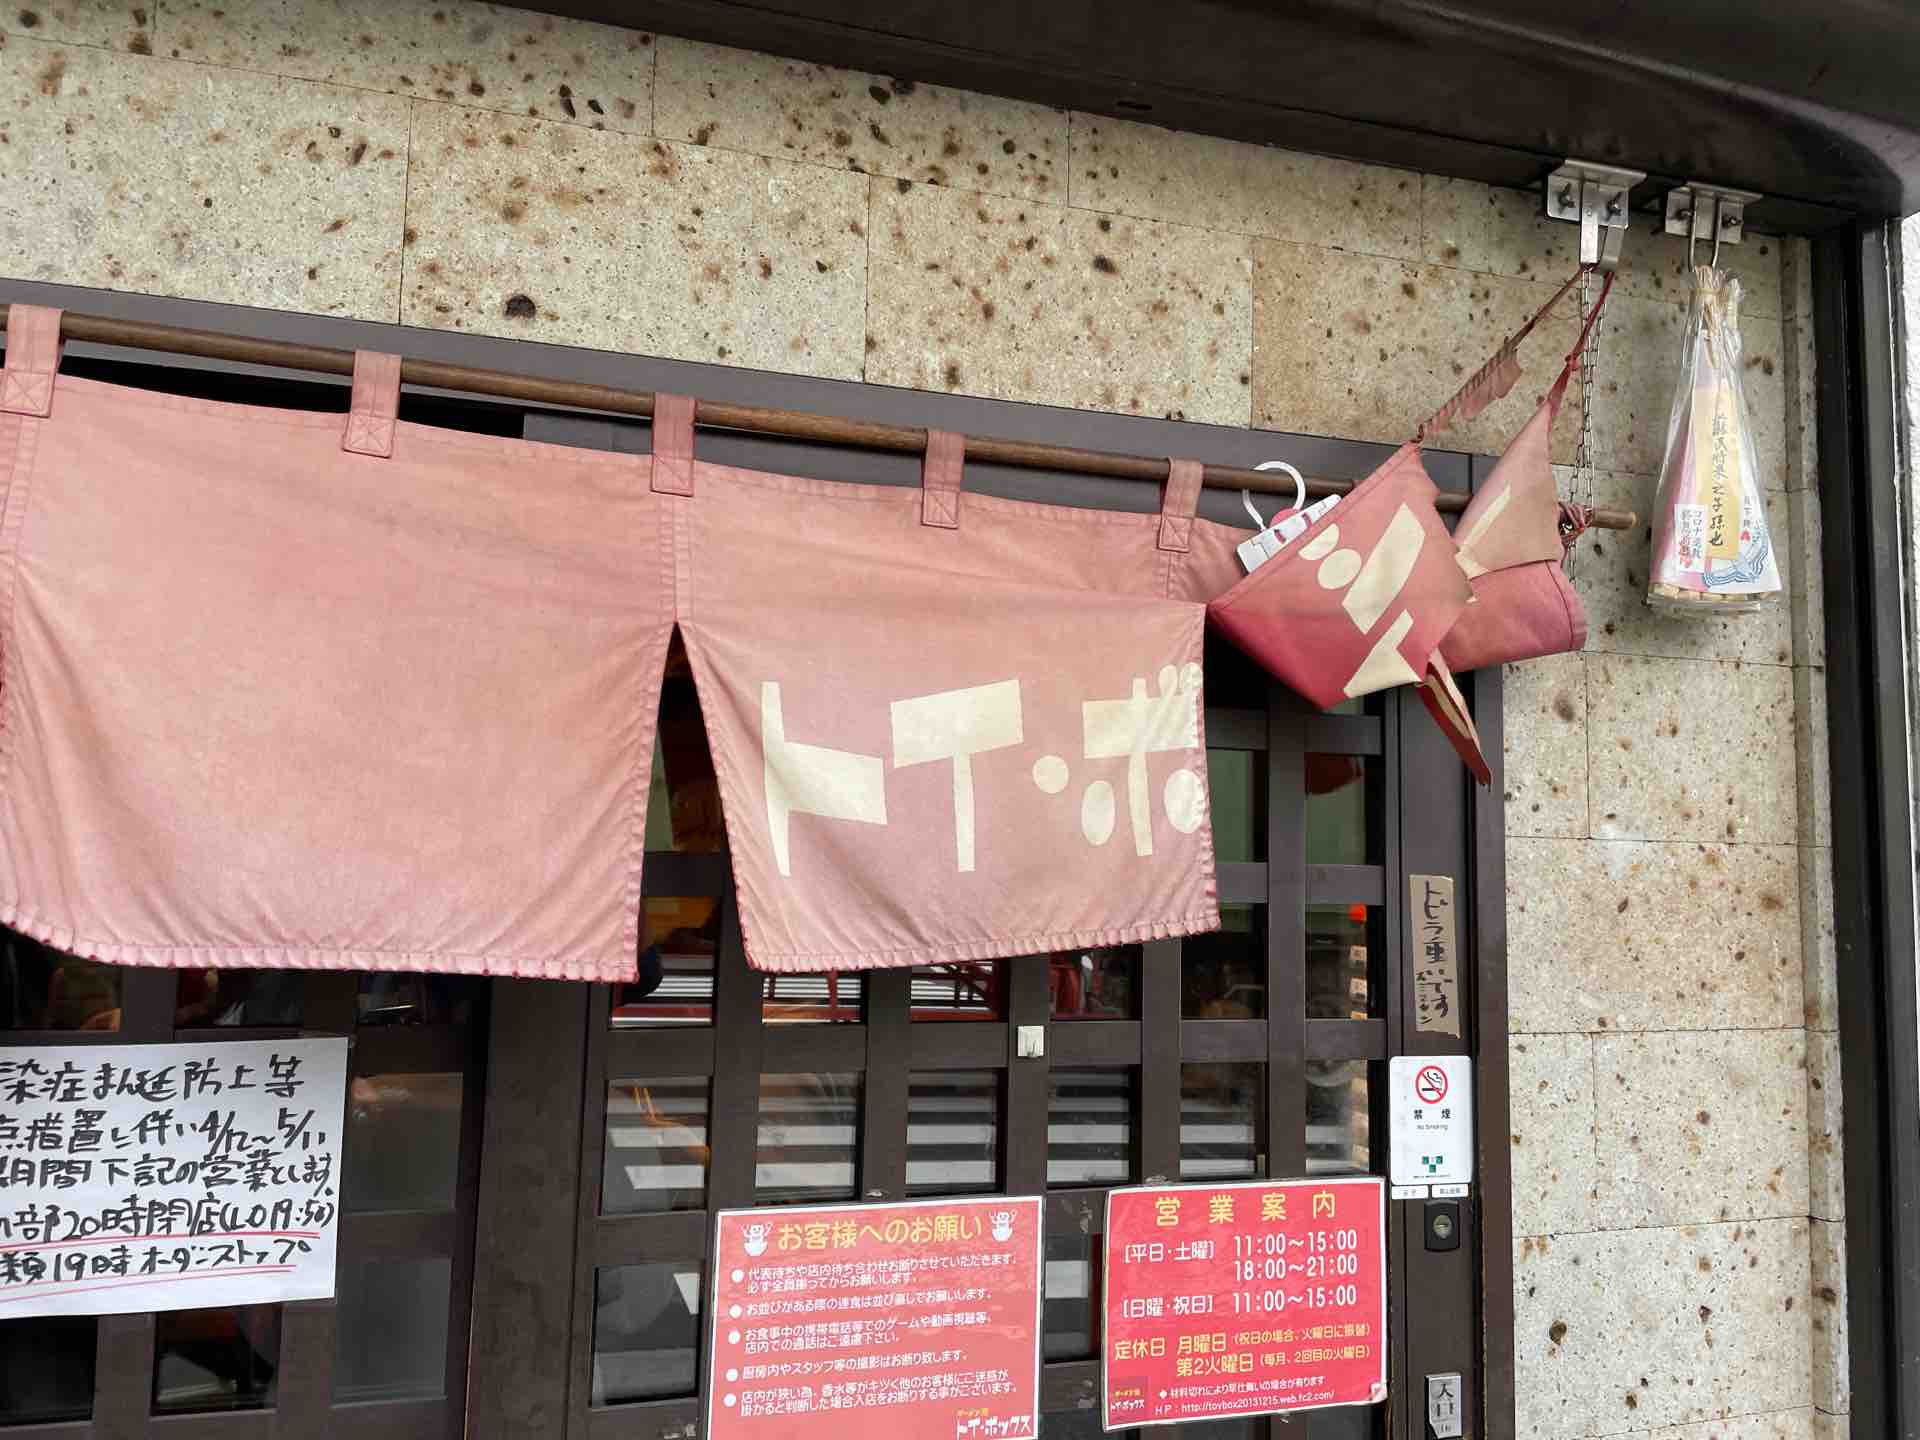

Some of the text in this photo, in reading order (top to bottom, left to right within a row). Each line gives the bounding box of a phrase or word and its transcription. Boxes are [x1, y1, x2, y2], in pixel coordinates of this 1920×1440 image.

[1413, 1108, 1452, 1121] 禁煙
[1154, 1190, 1336, 1227] 営業案内
[777, 1215, 982, 1251] お客様へのお願い
[1114, 1336, 1167, 1361] 定休日
[1176, 1332, 1227, 1355] 月曜日
[1176, 1352, 1254, 1378] 第2火曜日
[1436, 1383, 1454, 1417] 入口
